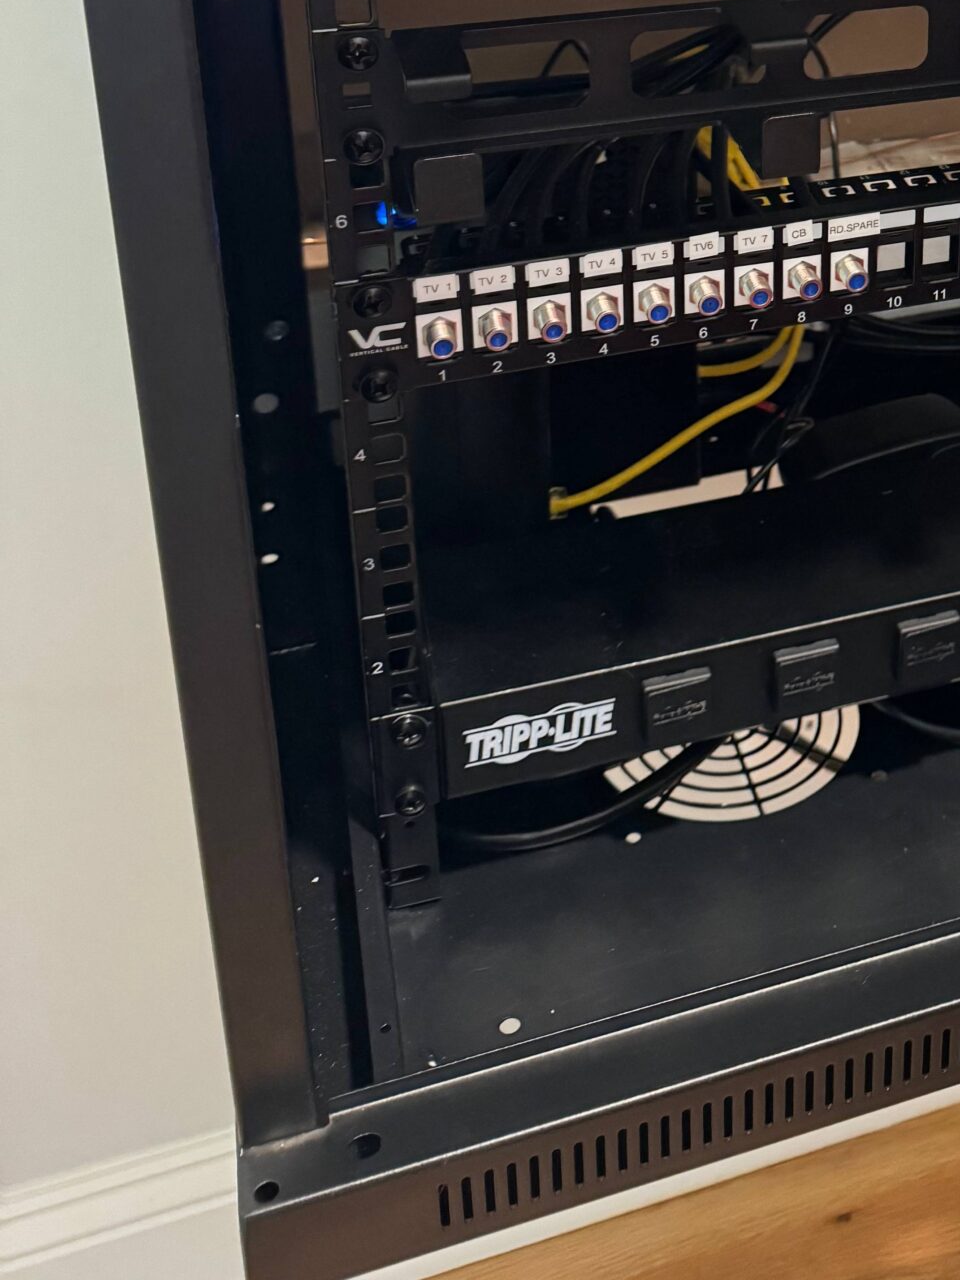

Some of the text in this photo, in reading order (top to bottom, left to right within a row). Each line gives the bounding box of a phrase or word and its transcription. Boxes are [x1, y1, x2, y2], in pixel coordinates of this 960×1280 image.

[336, 214, 348, 228] 6
[791, 228, 807, 239] CB
[829, 220, 879, 235] RD.SPARE
[693, 240, 713, 252] TV6
[742, 234, 769, 246] TV 7
[641, 249, 669, 262] TV 5
[588, 258, 616, 270] TV 4
[478, 275, 507, 286] TV 2
[933, 289, 947, 301] 11
[886, 296, 903, 309] 10
[844, 303, 853, 315] 9
[798, 311, 806, 323] 8
[750, 319, 758, 331] 7
[347, 321, 407, 349] VC
[699, 327, 708, 339] 6
[650, 334, 659, 347] 5
[598, 343, 609, 355] 4
[546, 352, 556, 364] 3
[492, 361, 503, 373] 2
[439, 370, 446, 381] 1
[355, 449, 366, 462] 4
[363, 557, 375, 571] 3
[371, 662, 383, 675] 2
